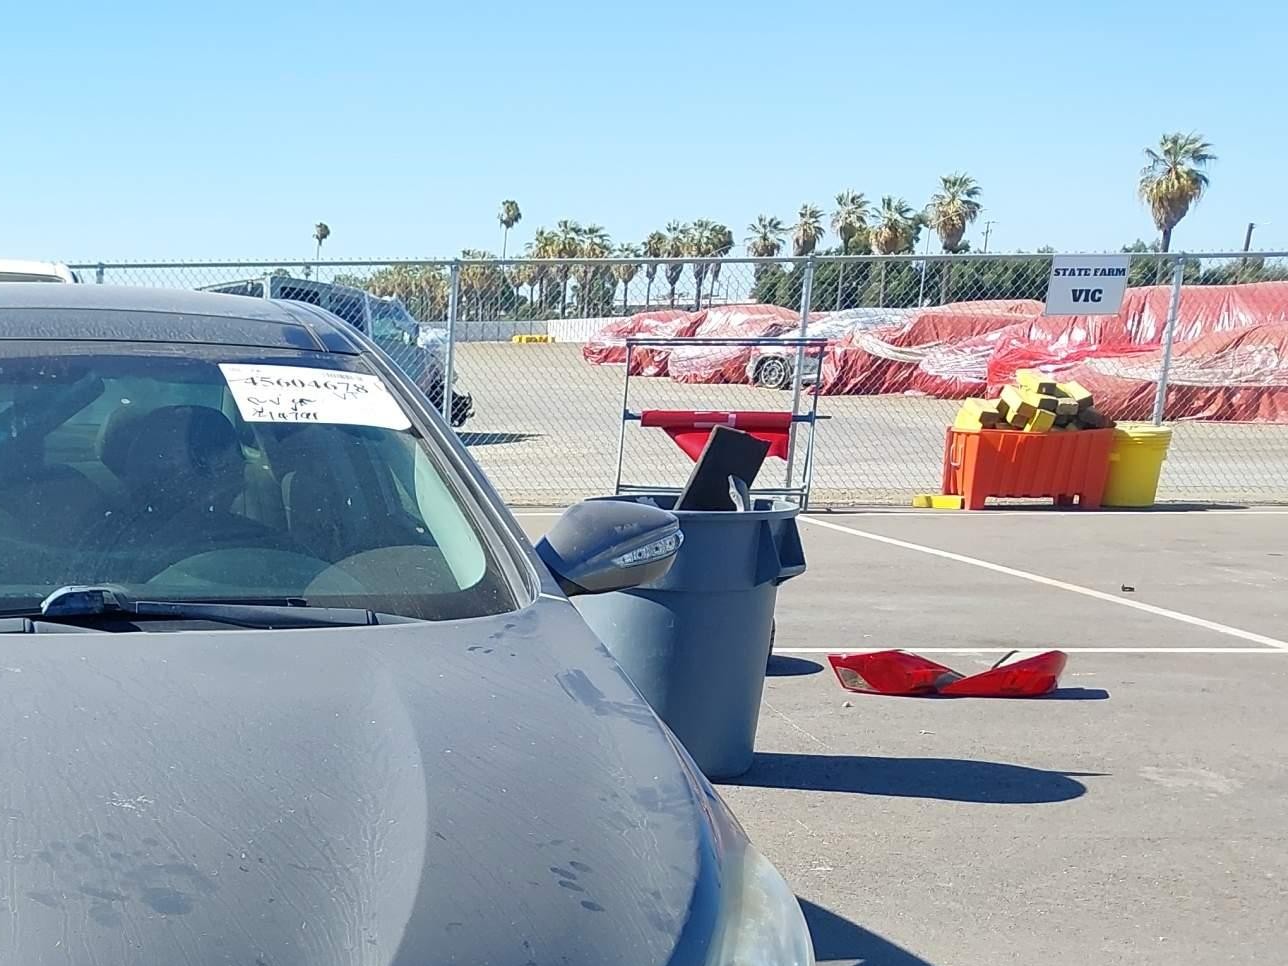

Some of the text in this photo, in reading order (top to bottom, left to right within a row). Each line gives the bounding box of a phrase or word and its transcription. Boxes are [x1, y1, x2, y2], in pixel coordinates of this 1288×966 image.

[1053, 267, 1126, 277] STATE FARM
[1071, 288, 1103, 303] VIC
